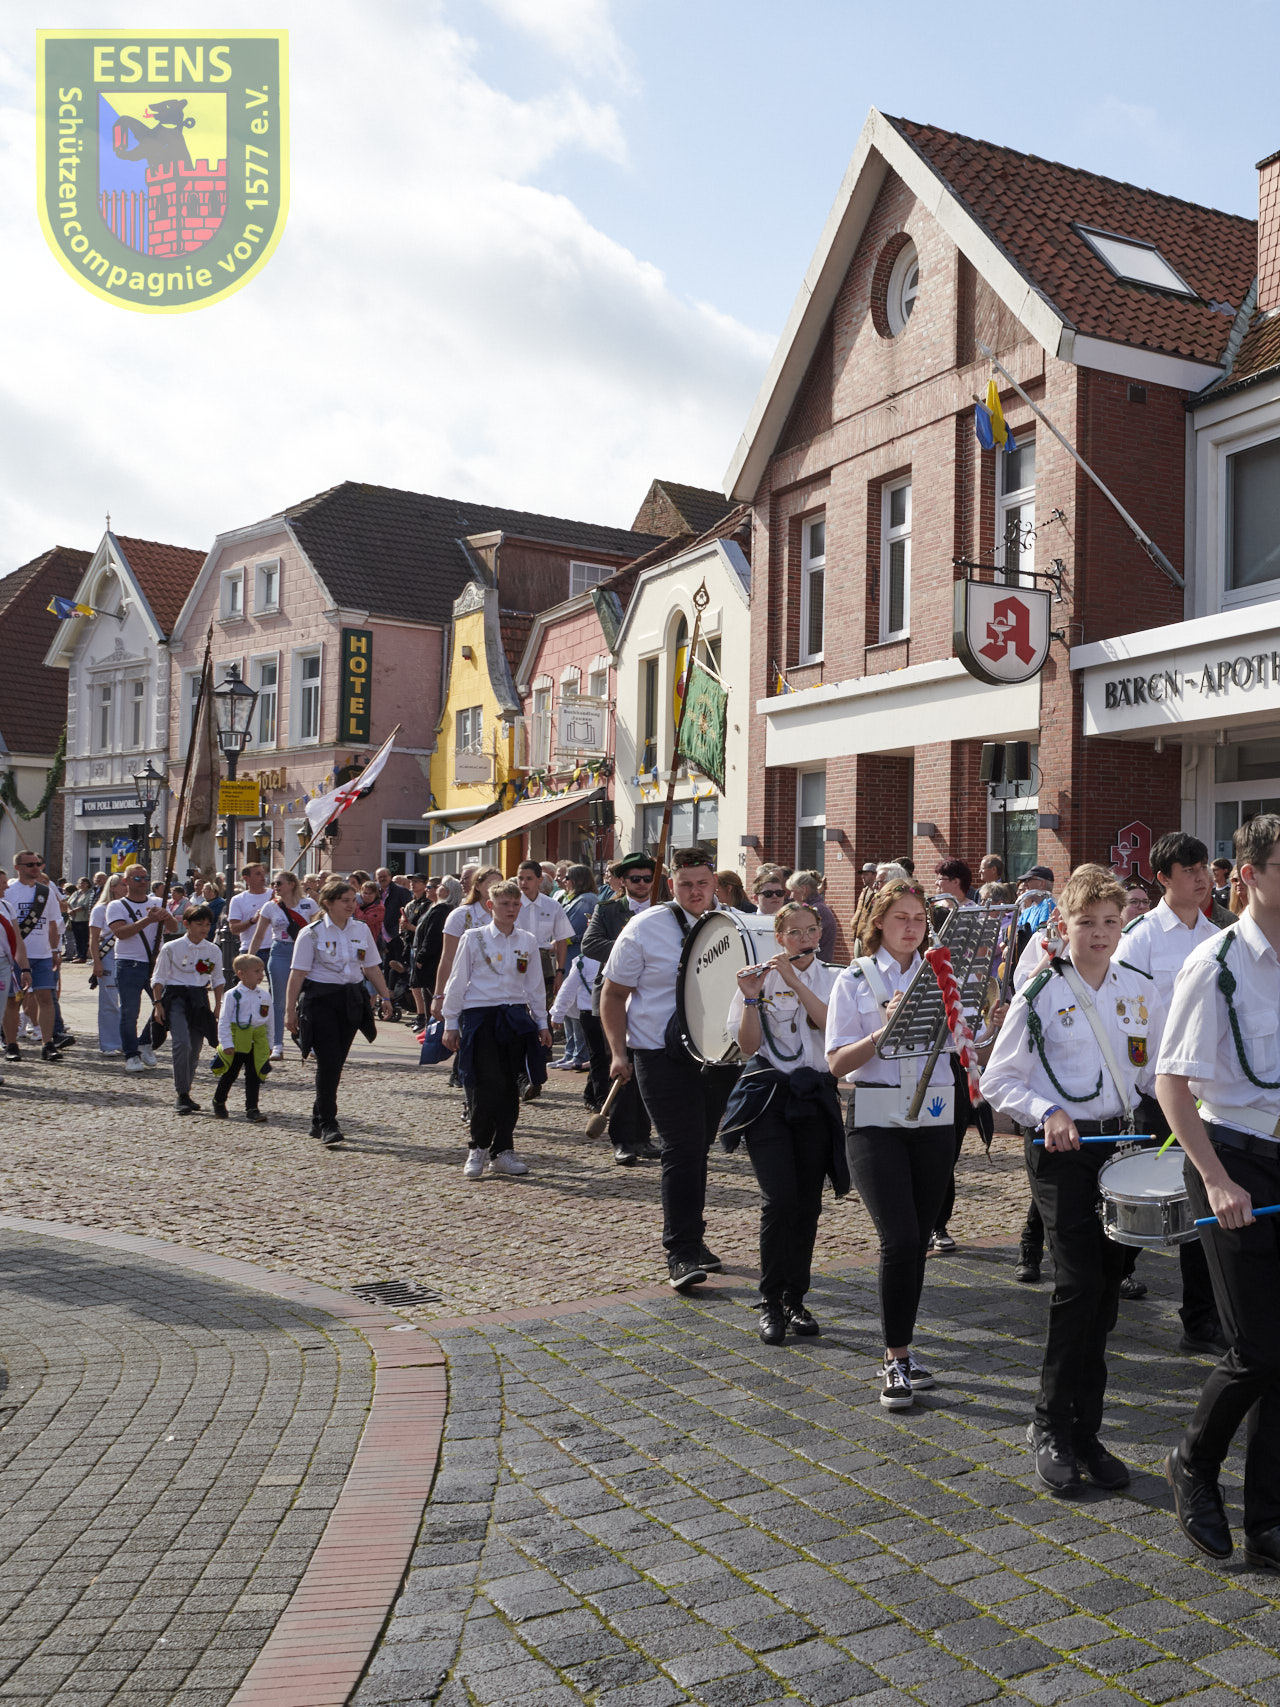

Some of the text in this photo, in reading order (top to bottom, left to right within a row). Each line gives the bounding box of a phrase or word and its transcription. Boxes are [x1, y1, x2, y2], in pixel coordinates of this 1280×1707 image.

[349, 635, 368, 735] HOTEL
[84, 802, 96, 811] VON
[97, 801, 111, 811] POLL
[702, 935, 730, 968] SONOR
